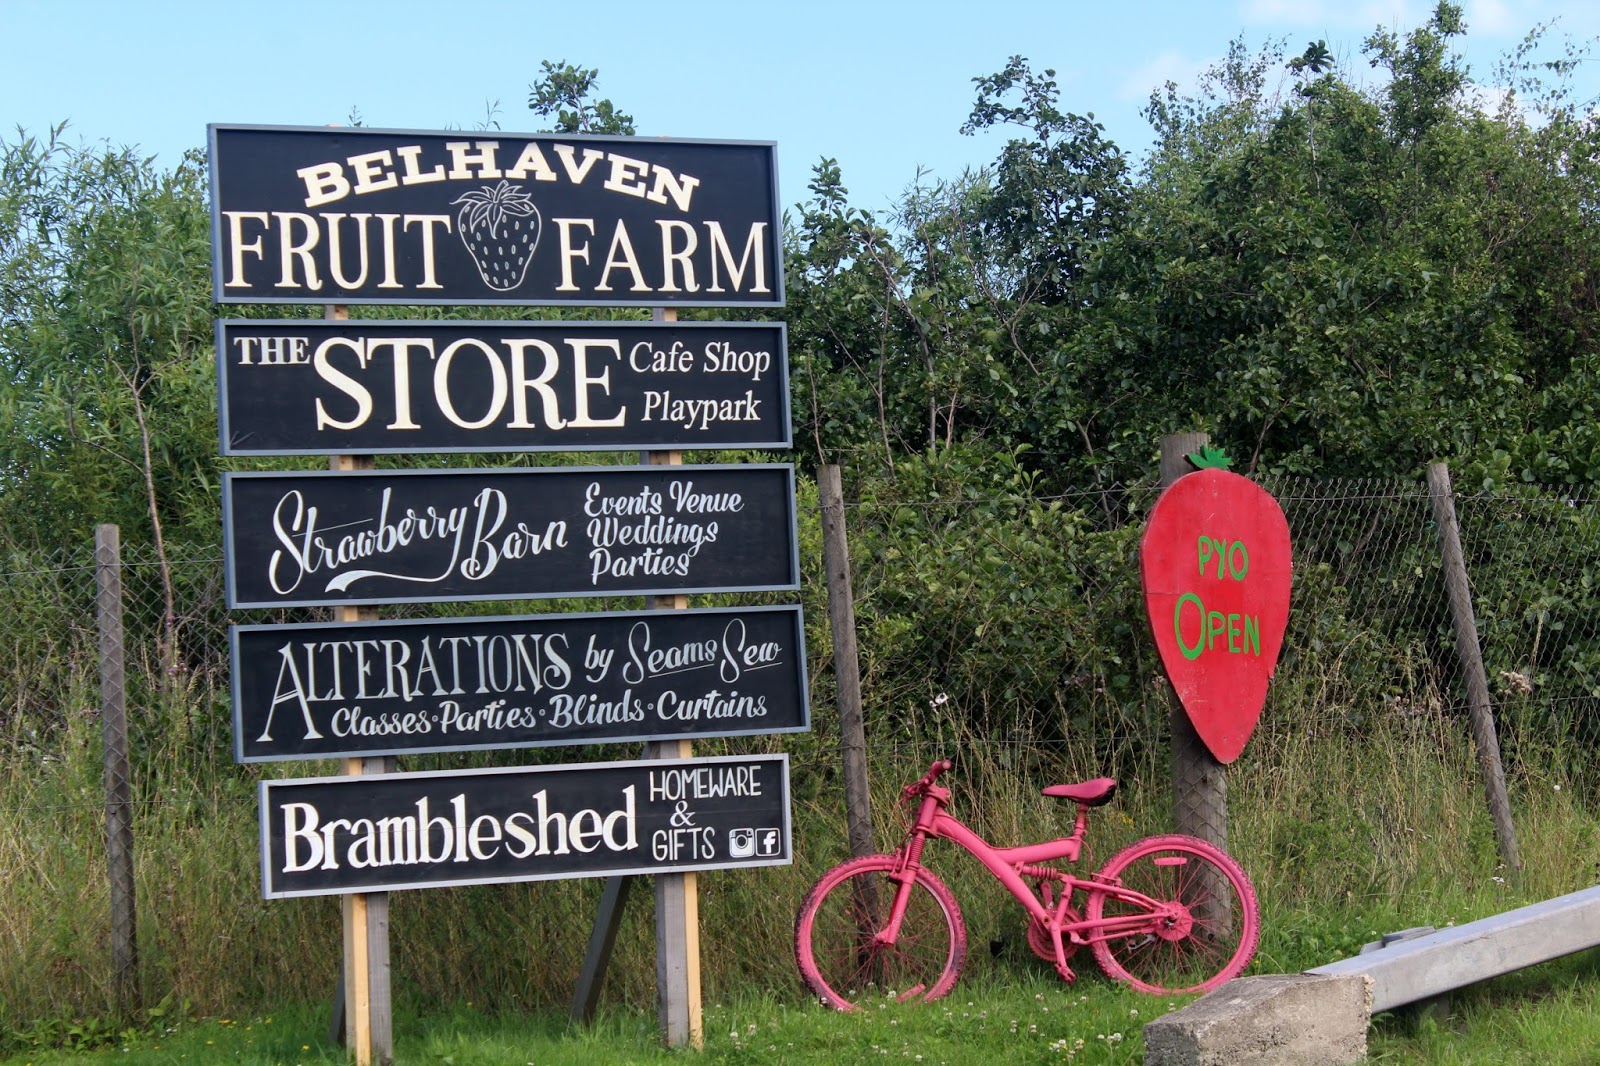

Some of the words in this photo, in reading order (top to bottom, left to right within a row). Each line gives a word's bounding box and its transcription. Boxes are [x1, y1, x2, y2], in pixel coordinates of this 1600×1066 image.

[297, 141, 699, 212] BELHAVEN
[222, 211, 452, 291] FRUIT
[552, 218, 771, 293] FARM
[630, 341, 693, 373] Cafe
[703, 342, 771, 381] Shop
[234, 337, 310, 365] THE
[315, 337, 626, 432] STORE
[641, 390, 761, 430] Playpark
[585, 481, 662, 518] Events
[669, 481, 744, 513] Venue
[269, 486, 467, 595] Strawberry
[460, 487, 568, 580] Barn
[586, 515, 718, 557] Weddings
[589, 547, 689, 585] Parties
[1198, 536, 1248, 581] PYO
[256, 633, 572, 742] ALTERATIONS
[585, 634, 614, 683] by
[622, 620, 717, 684] Seams
[720, 618, 782, 683] Sew
[331, 706, 430, 738] Classes
[439, 700, 535, 738] Parties
[548, 690, 645, 728] Blinds
[656, 690, 767, 721] Curtains
[650, 765, 761, 801] HOMEWARE
[280, 784, 639, 874] Brambleshed
[669, 800, 695, 826] &
[651, 826, 715, 861] GIFTS
